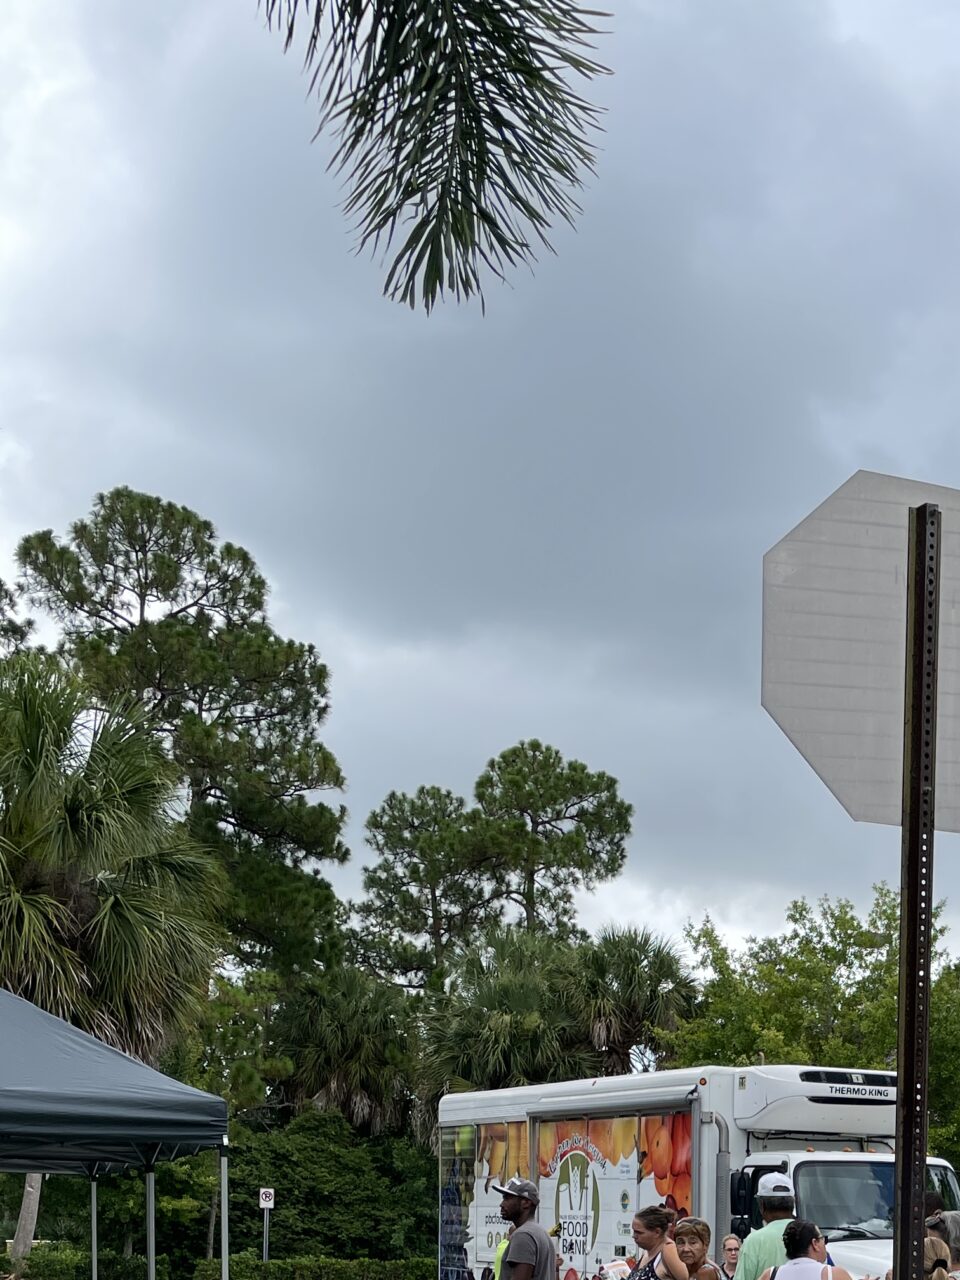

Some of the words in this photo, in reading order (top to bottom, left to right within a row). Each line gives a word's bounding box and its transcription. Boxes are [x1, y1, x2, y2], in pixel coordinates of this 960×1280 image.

[829, 1086, 867, 1096] THERMO
[868, 1088, 889, 1097] KING
[562, 1221, 589, 1238] FOOD
